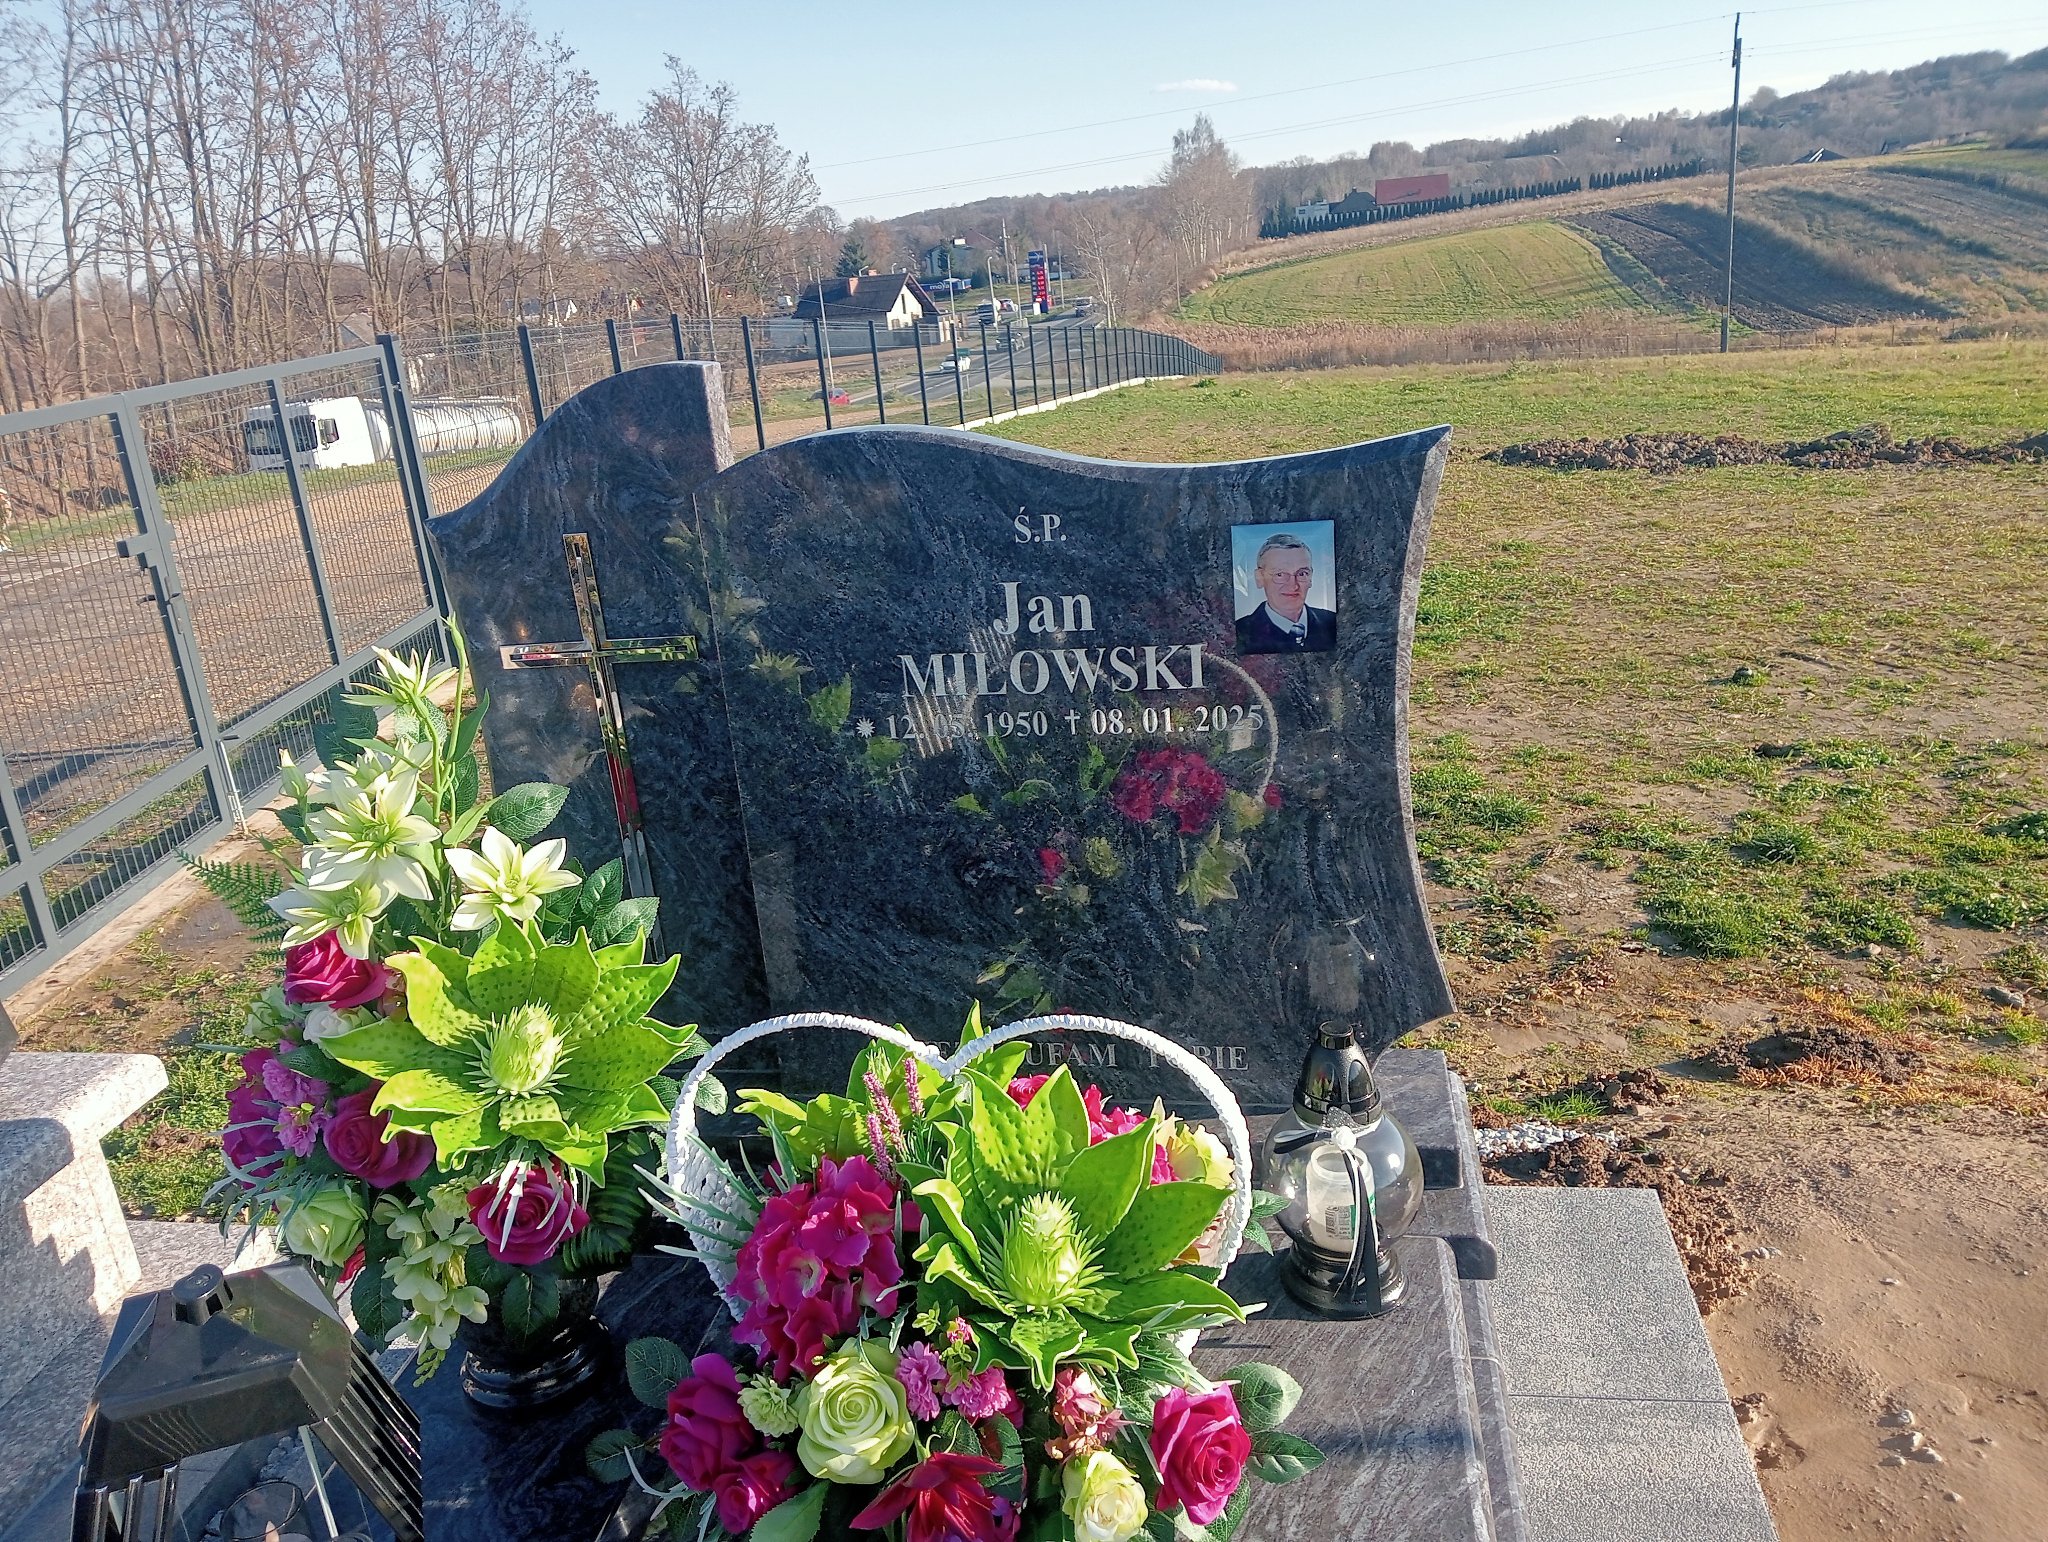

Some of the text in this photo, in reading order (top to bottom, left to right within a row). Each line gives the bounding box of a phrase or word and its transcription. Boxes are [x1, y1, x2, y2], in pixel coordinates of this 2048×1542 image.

[1014, 506, 1067, 543] Ś.P.
[993, 581, 1096, 634] Jan
[897, 643, 1207, 696] MILOWSKI
[886, 713, 926, 740] 12.
[984, 710, 1048, 738] 1950
[1091, 708, 1133, 735] 08.
[1142, 706, 1184, 733] 01.
[1194, 704, 1264, 732] 2025
[1026, 1042, 1249, 1070] UFAM TBIE
